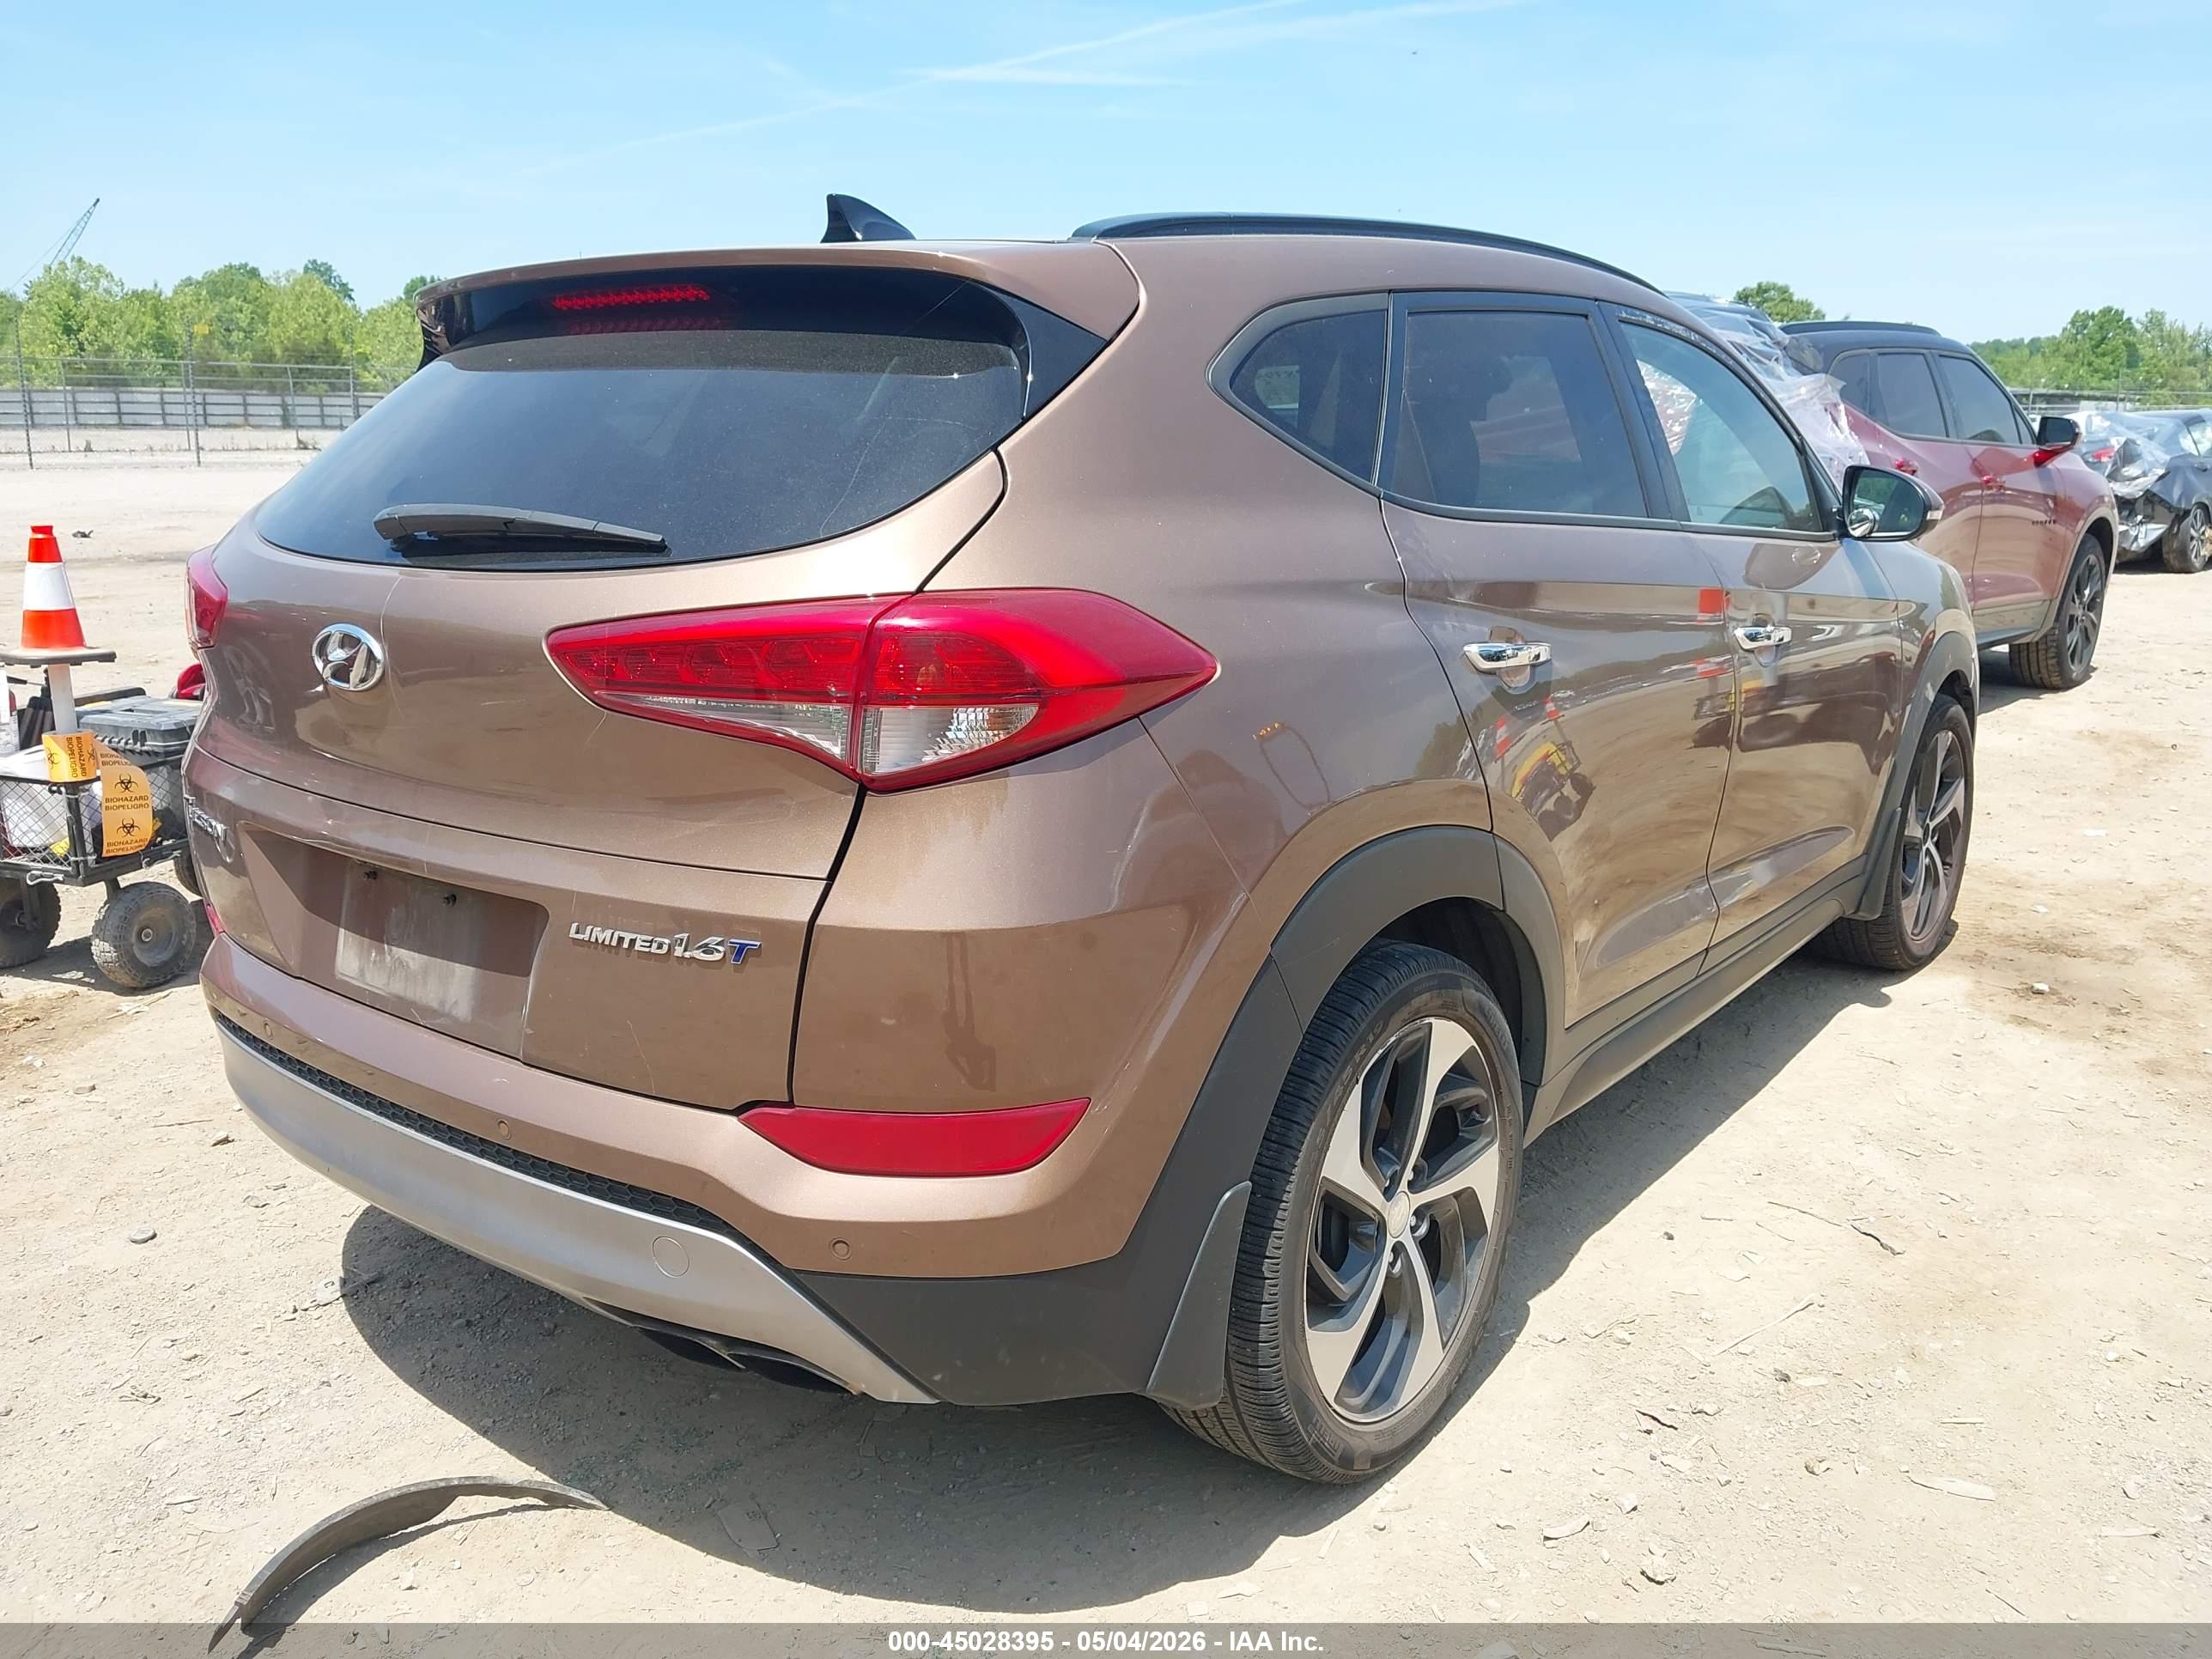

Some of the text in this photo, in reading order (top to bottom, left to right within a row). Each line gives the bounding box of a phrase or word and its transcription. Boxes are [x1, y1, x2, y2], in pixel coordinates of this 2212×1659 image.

[66, 737, 78, 778] BIOPELIGRO
[76, 736, 87, 777] BIOHAZARD
[105, 795, 149, 804] BIOHAZARD
[105, 803, 149, 811] BIOPELIGRO
[568, 922, 763, 964] LIMITED 1.6T
